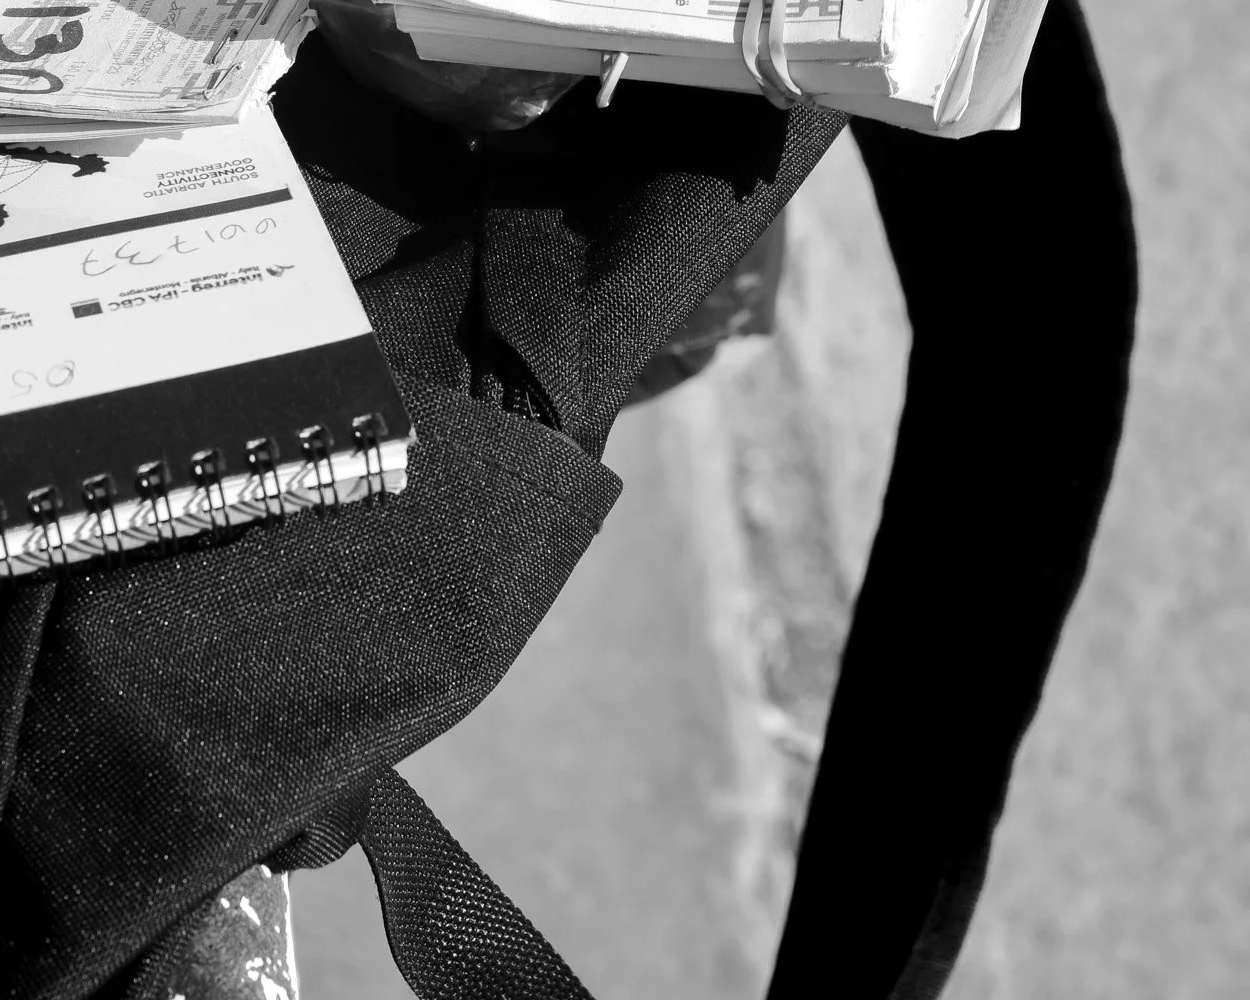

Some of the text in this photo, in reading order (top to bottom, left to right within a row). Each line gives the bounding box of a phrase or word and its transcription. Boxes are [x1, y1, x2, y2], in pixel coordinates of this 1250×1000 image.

[156, 156, 254, 180] GOVERNANCE
[156, 164, 257, 189] CONNECTIVITY
[142, 171, 260, 199] SOUTH ADRIATIC
[189, 271, 230, 283] Albania
[238, 265, 260, 275] Italy
[118, 280, 182, 299] Montenegro
[107, 296, 146, 312] CBC
[10, 312, 31, 320] Italy
